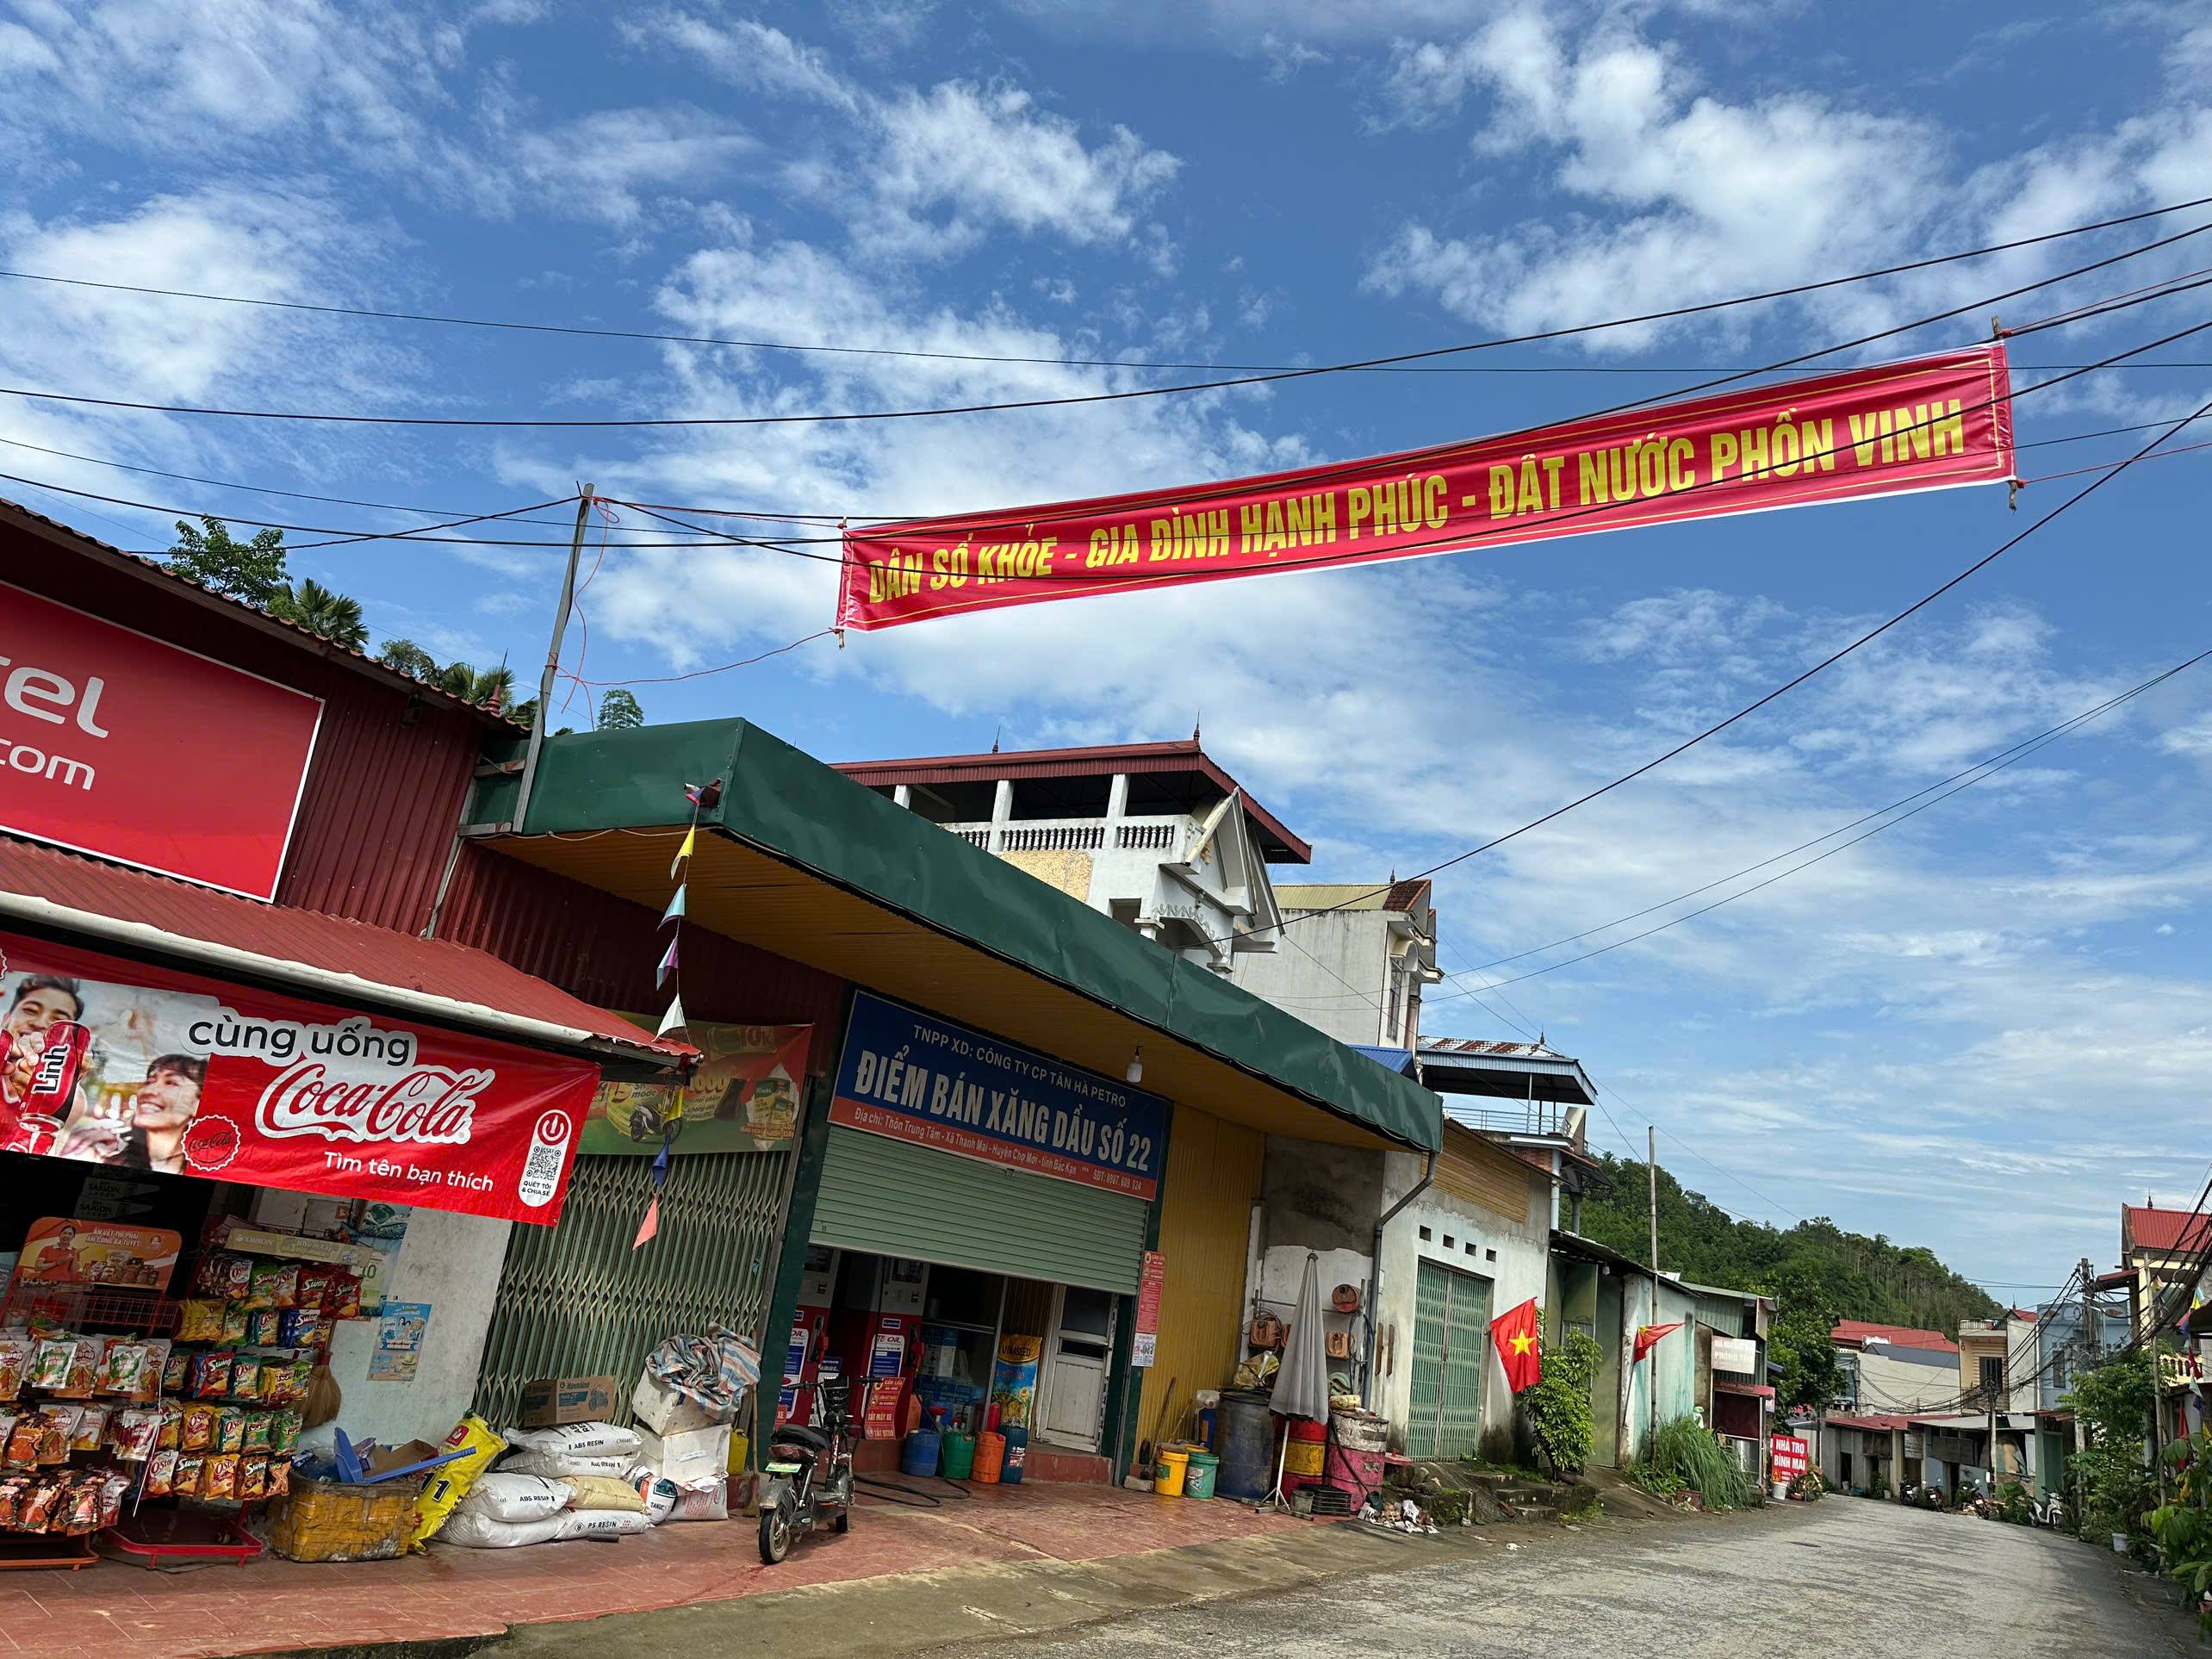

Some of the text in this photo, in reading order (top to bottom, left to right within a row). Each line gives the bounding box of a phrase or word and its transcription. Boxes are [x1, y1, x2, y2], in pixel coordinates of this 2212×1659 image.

[869, 547, 923, 604] DÂN
[929, 532, 974, 591] SỐ
[1085, 524, 1139, 569] GIA
[1148, 507, 1229, 562] ĐÌNH
[1240, 491, 1336, 558] HẠNH
[1347, 472, 1448, 540] PHÚC
[1578, 432, 1696, 506] NƯỚC
[1710, 407, 1836, 483] PHỒN
[1848, 398, 1964, 467] VINH
[189, 1014, 409, 1066] cùng uống
[34, 1044, 70, 1094] Linh
[914, 1024, 1126, 1108] TNPP XD: CÔNG TY CP TÂN HÀ PETRO
[854, 1044, 1151, 1172] ĐIỂM BÁN XĂNG DẦU SỐ 22
[854, 1107, 868, 1124] Địa
[885, 1115, 904, 1131] Thôn
[904, 1120, 925, 1140] Trung
[926, 1126, 941, 1140] Tâm
[955, 1133, 976, 1151] Thanh
[324, 1151, 494, 1192] Tìm tên bạn thích
[302, 1277, 328, 1291] Swing
[209, 1358, 232, 1371] Swing
[177, 1457, 203, 1471] Swing
[1774, 1452, 1805, 1471] BÌNH MAI
[1775, 1438, 1790, 1452] NHÀ
